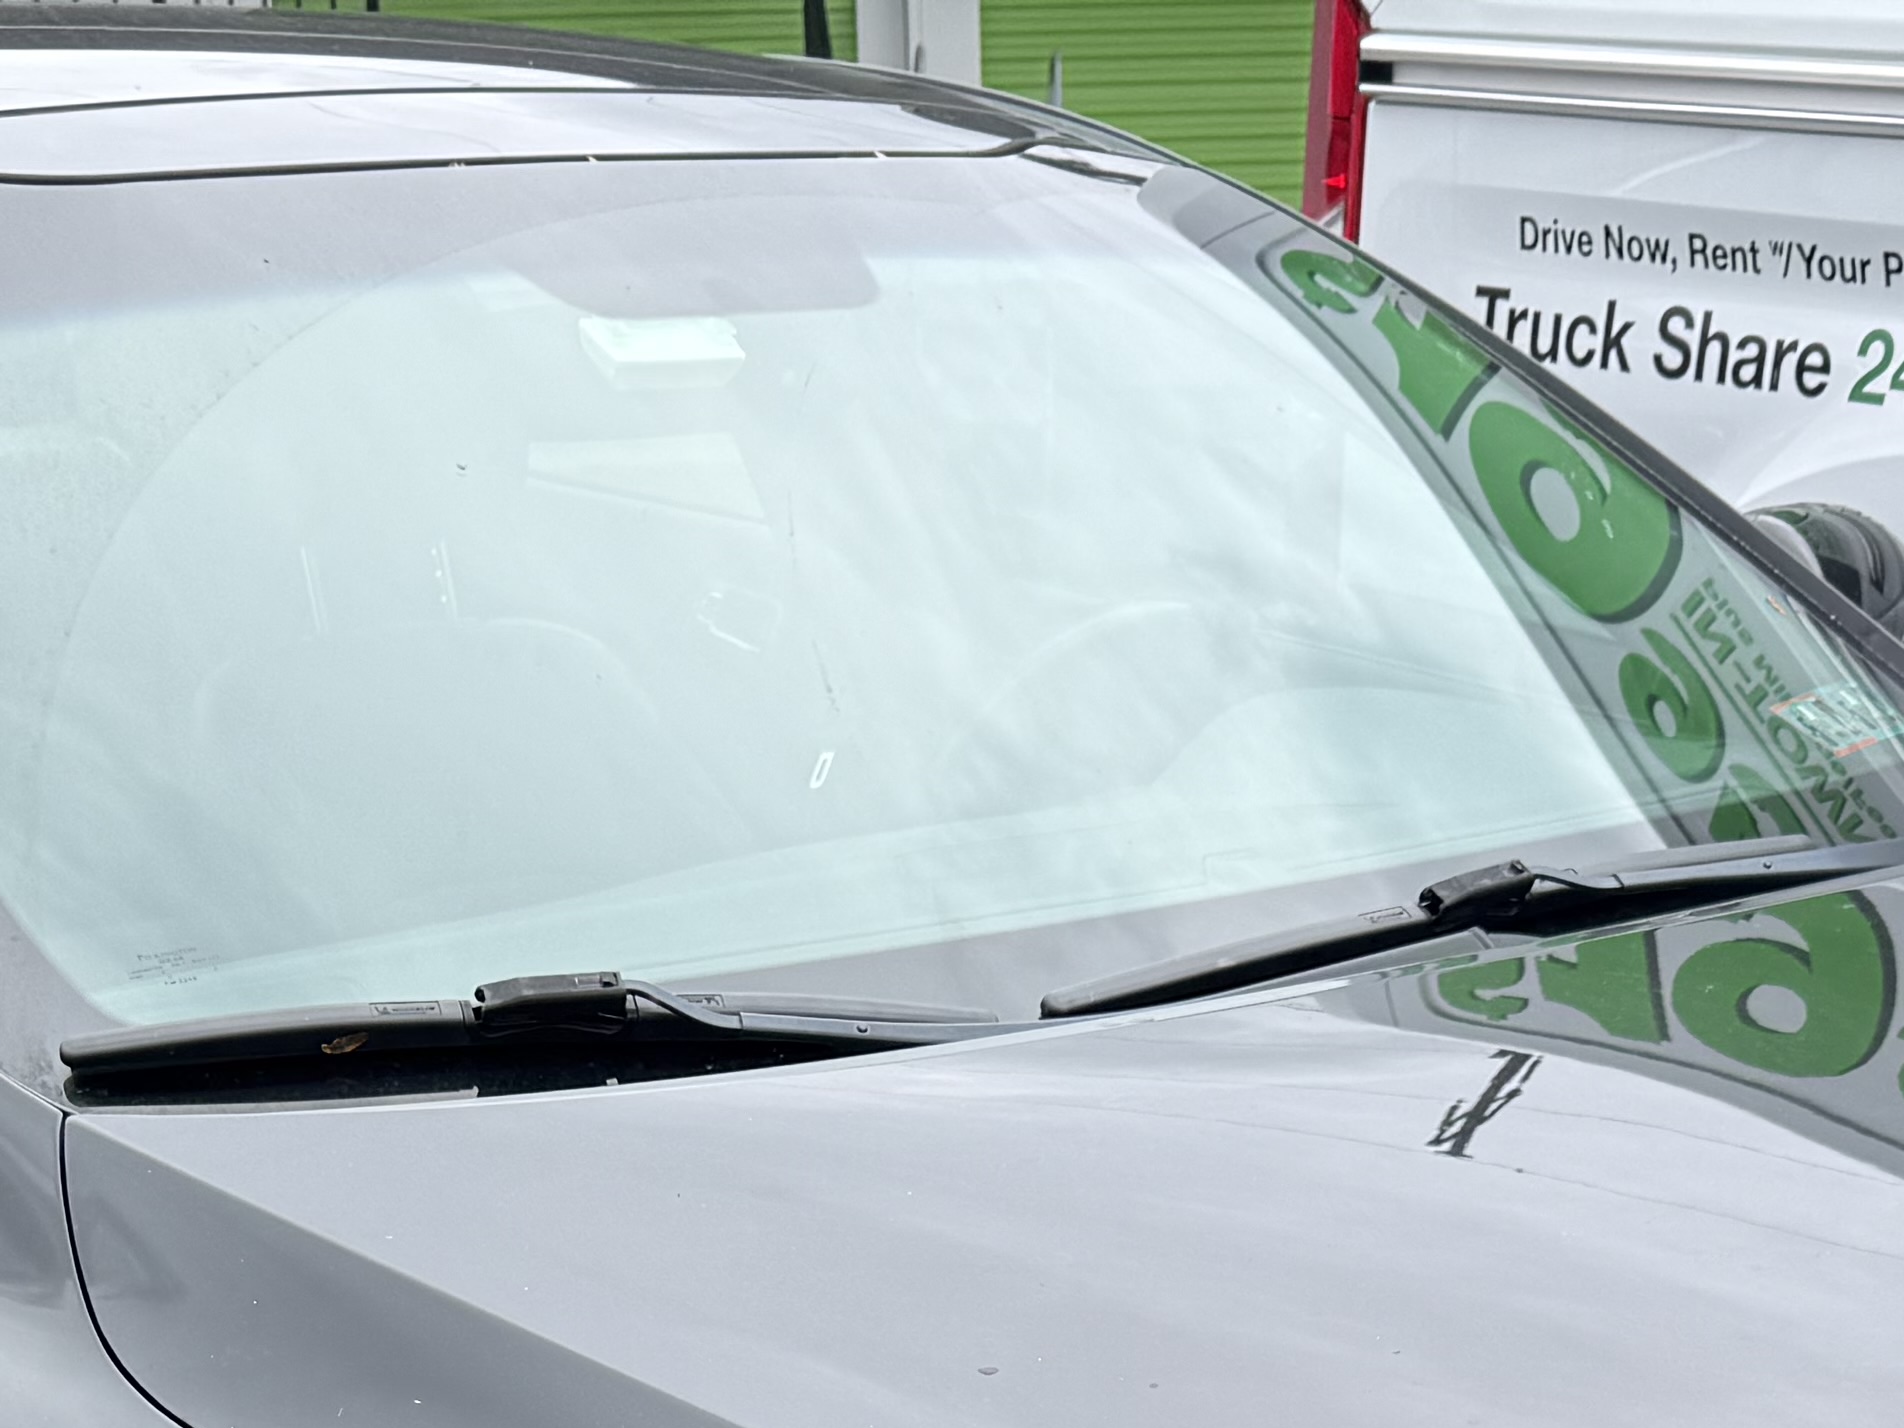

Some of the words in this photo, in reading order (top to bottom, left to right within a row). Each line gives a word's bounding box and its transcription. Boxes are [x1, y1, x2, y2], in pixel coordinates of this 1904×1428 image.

[1519, 216, 1593, 257] Drive
[1604, 224, 1678, 275] Now,
[1689, 233, 1761, 275] Rent
[1475, 285, 1636, 375] Truck
[1653, 305, 1832, 398] Share
